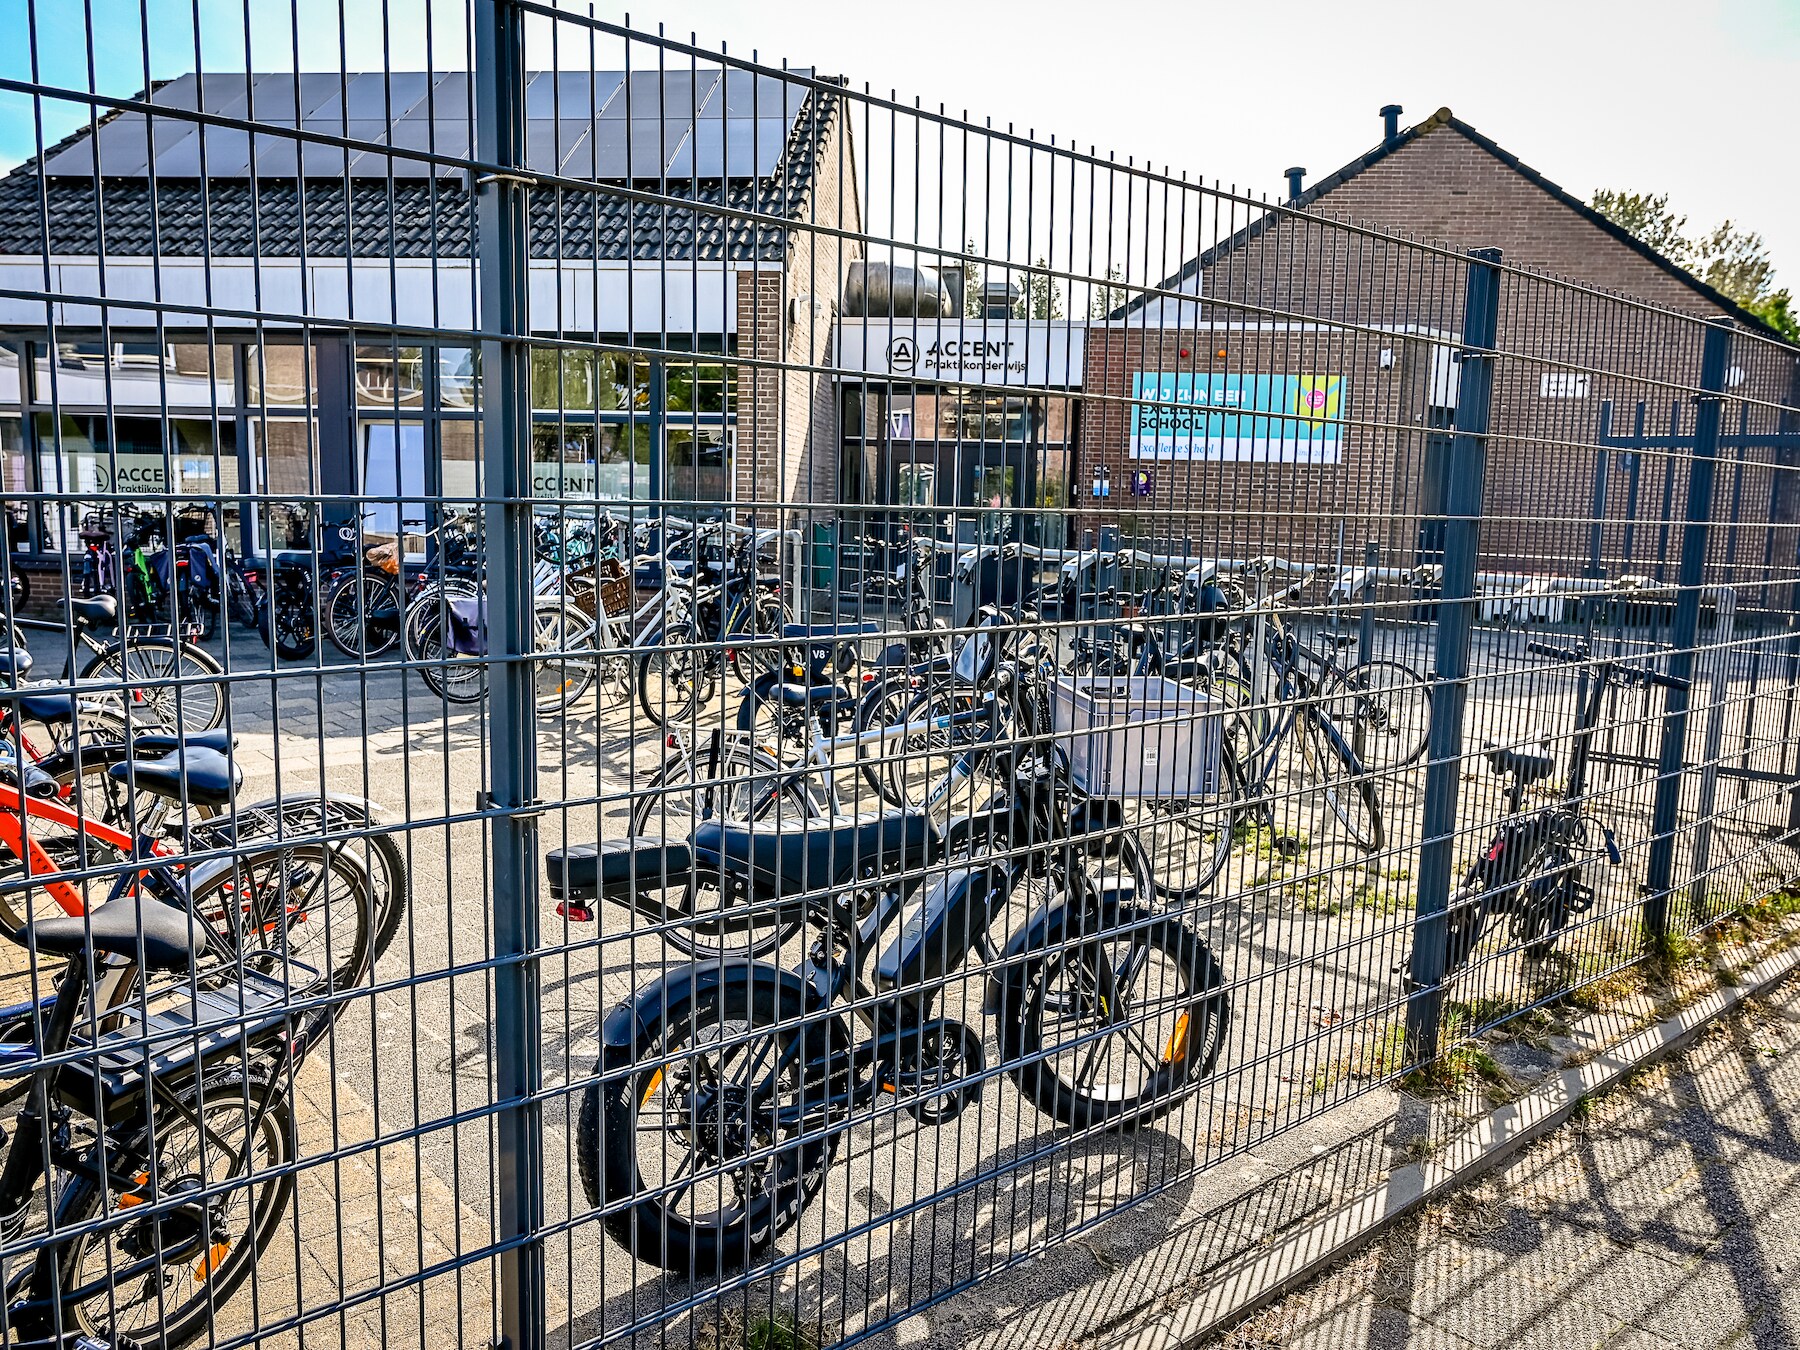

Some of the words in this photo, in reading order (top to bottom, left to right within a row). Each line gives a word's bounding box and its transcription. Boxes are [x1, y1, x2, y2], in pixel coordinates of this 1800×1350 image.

[926, 341, 1014, 357] ACCENT
[925, 359, 1027, 374] Praktikonderwijs
[1140, 417, 1203, 430] SCHOOL
[118, 468, 192, 484] ACCET
[534, 477, 594, 492] CCENT
[812, 650, 825, 659] V8
[1017, 947, 1064, 1026] KEND
